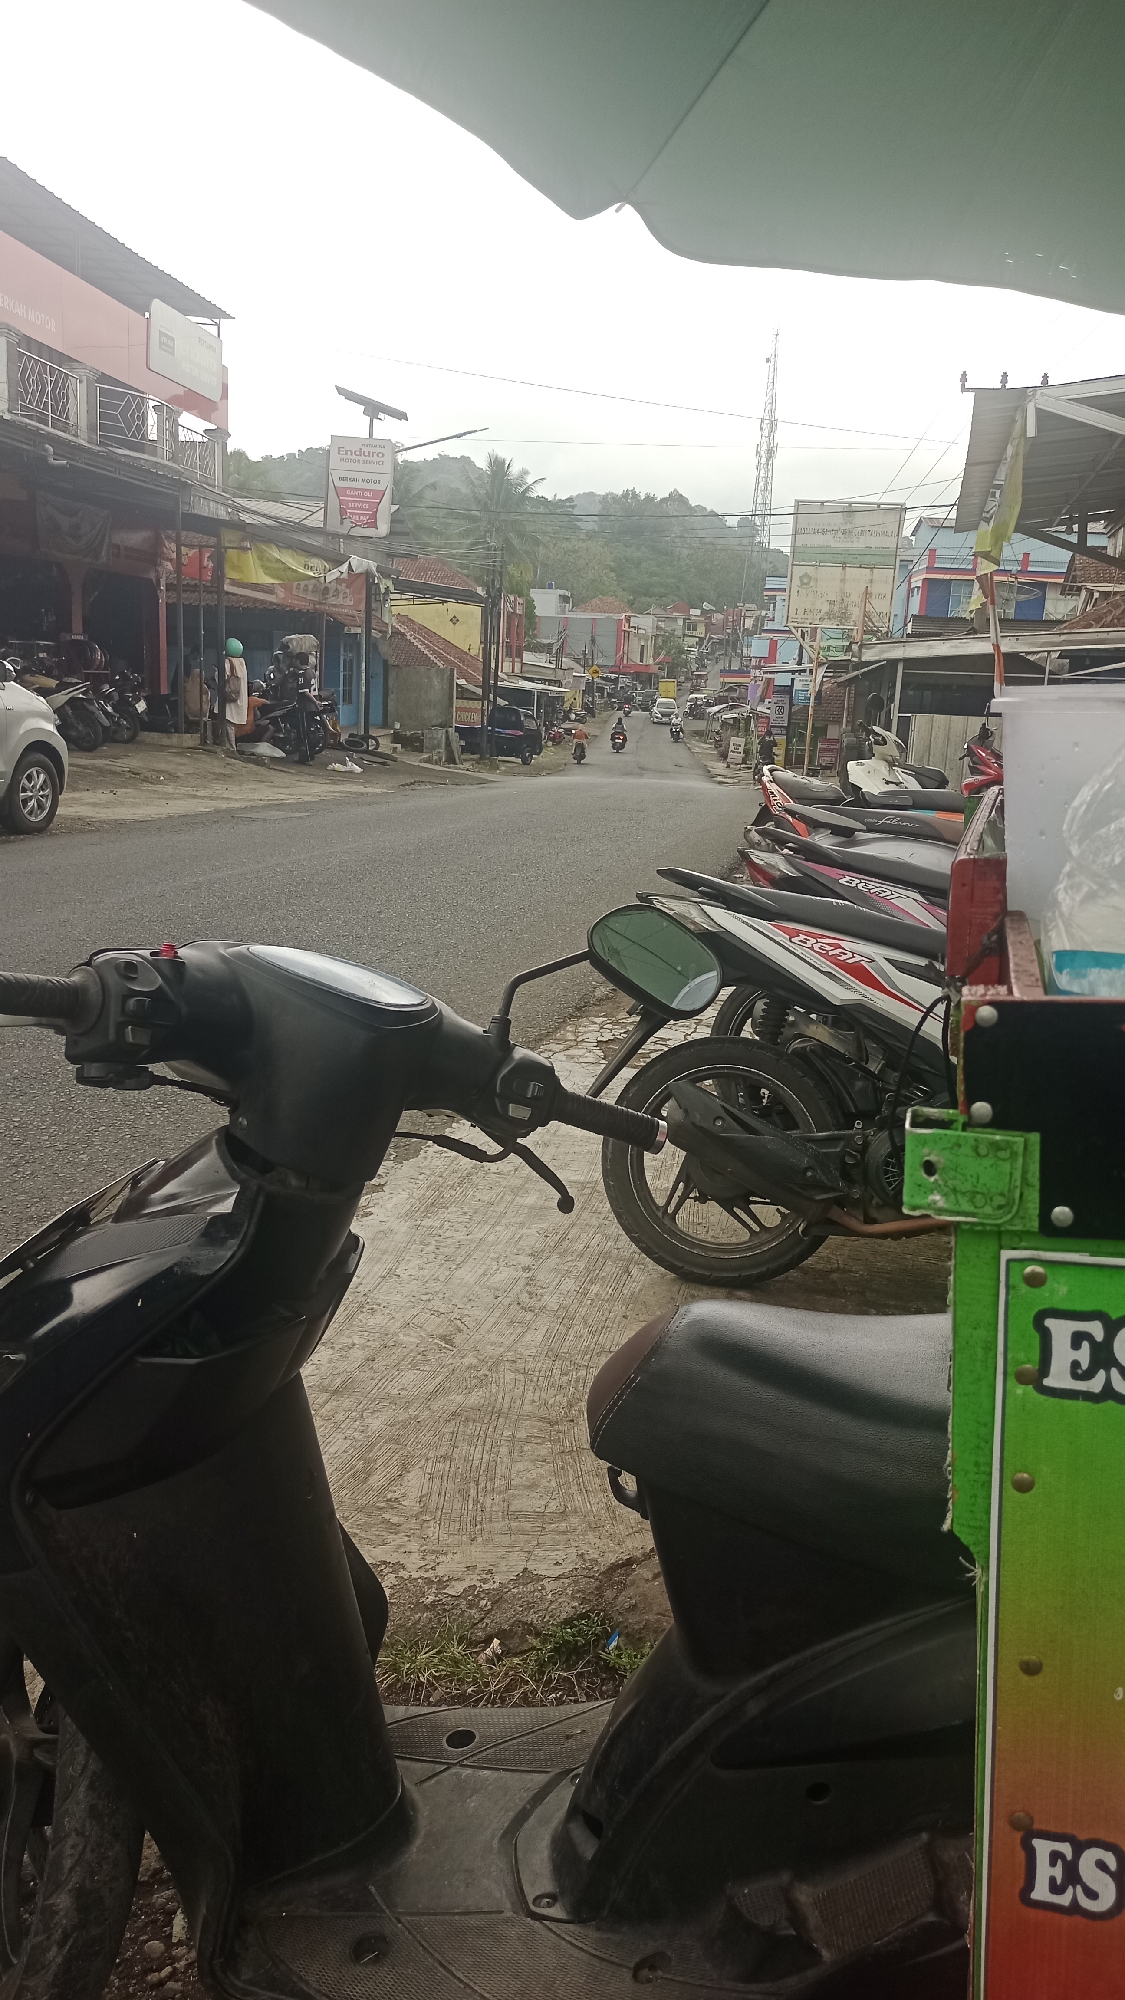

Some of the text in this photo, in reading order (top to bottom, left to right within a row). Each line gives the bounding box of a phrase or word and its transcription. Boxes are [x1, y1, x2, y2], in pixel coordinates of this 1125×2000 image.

[28, 307, 56, 333] MOTOR
[337, 446, 385, 459] Enduro
[1029, 1837, 1118, 1912] ES
